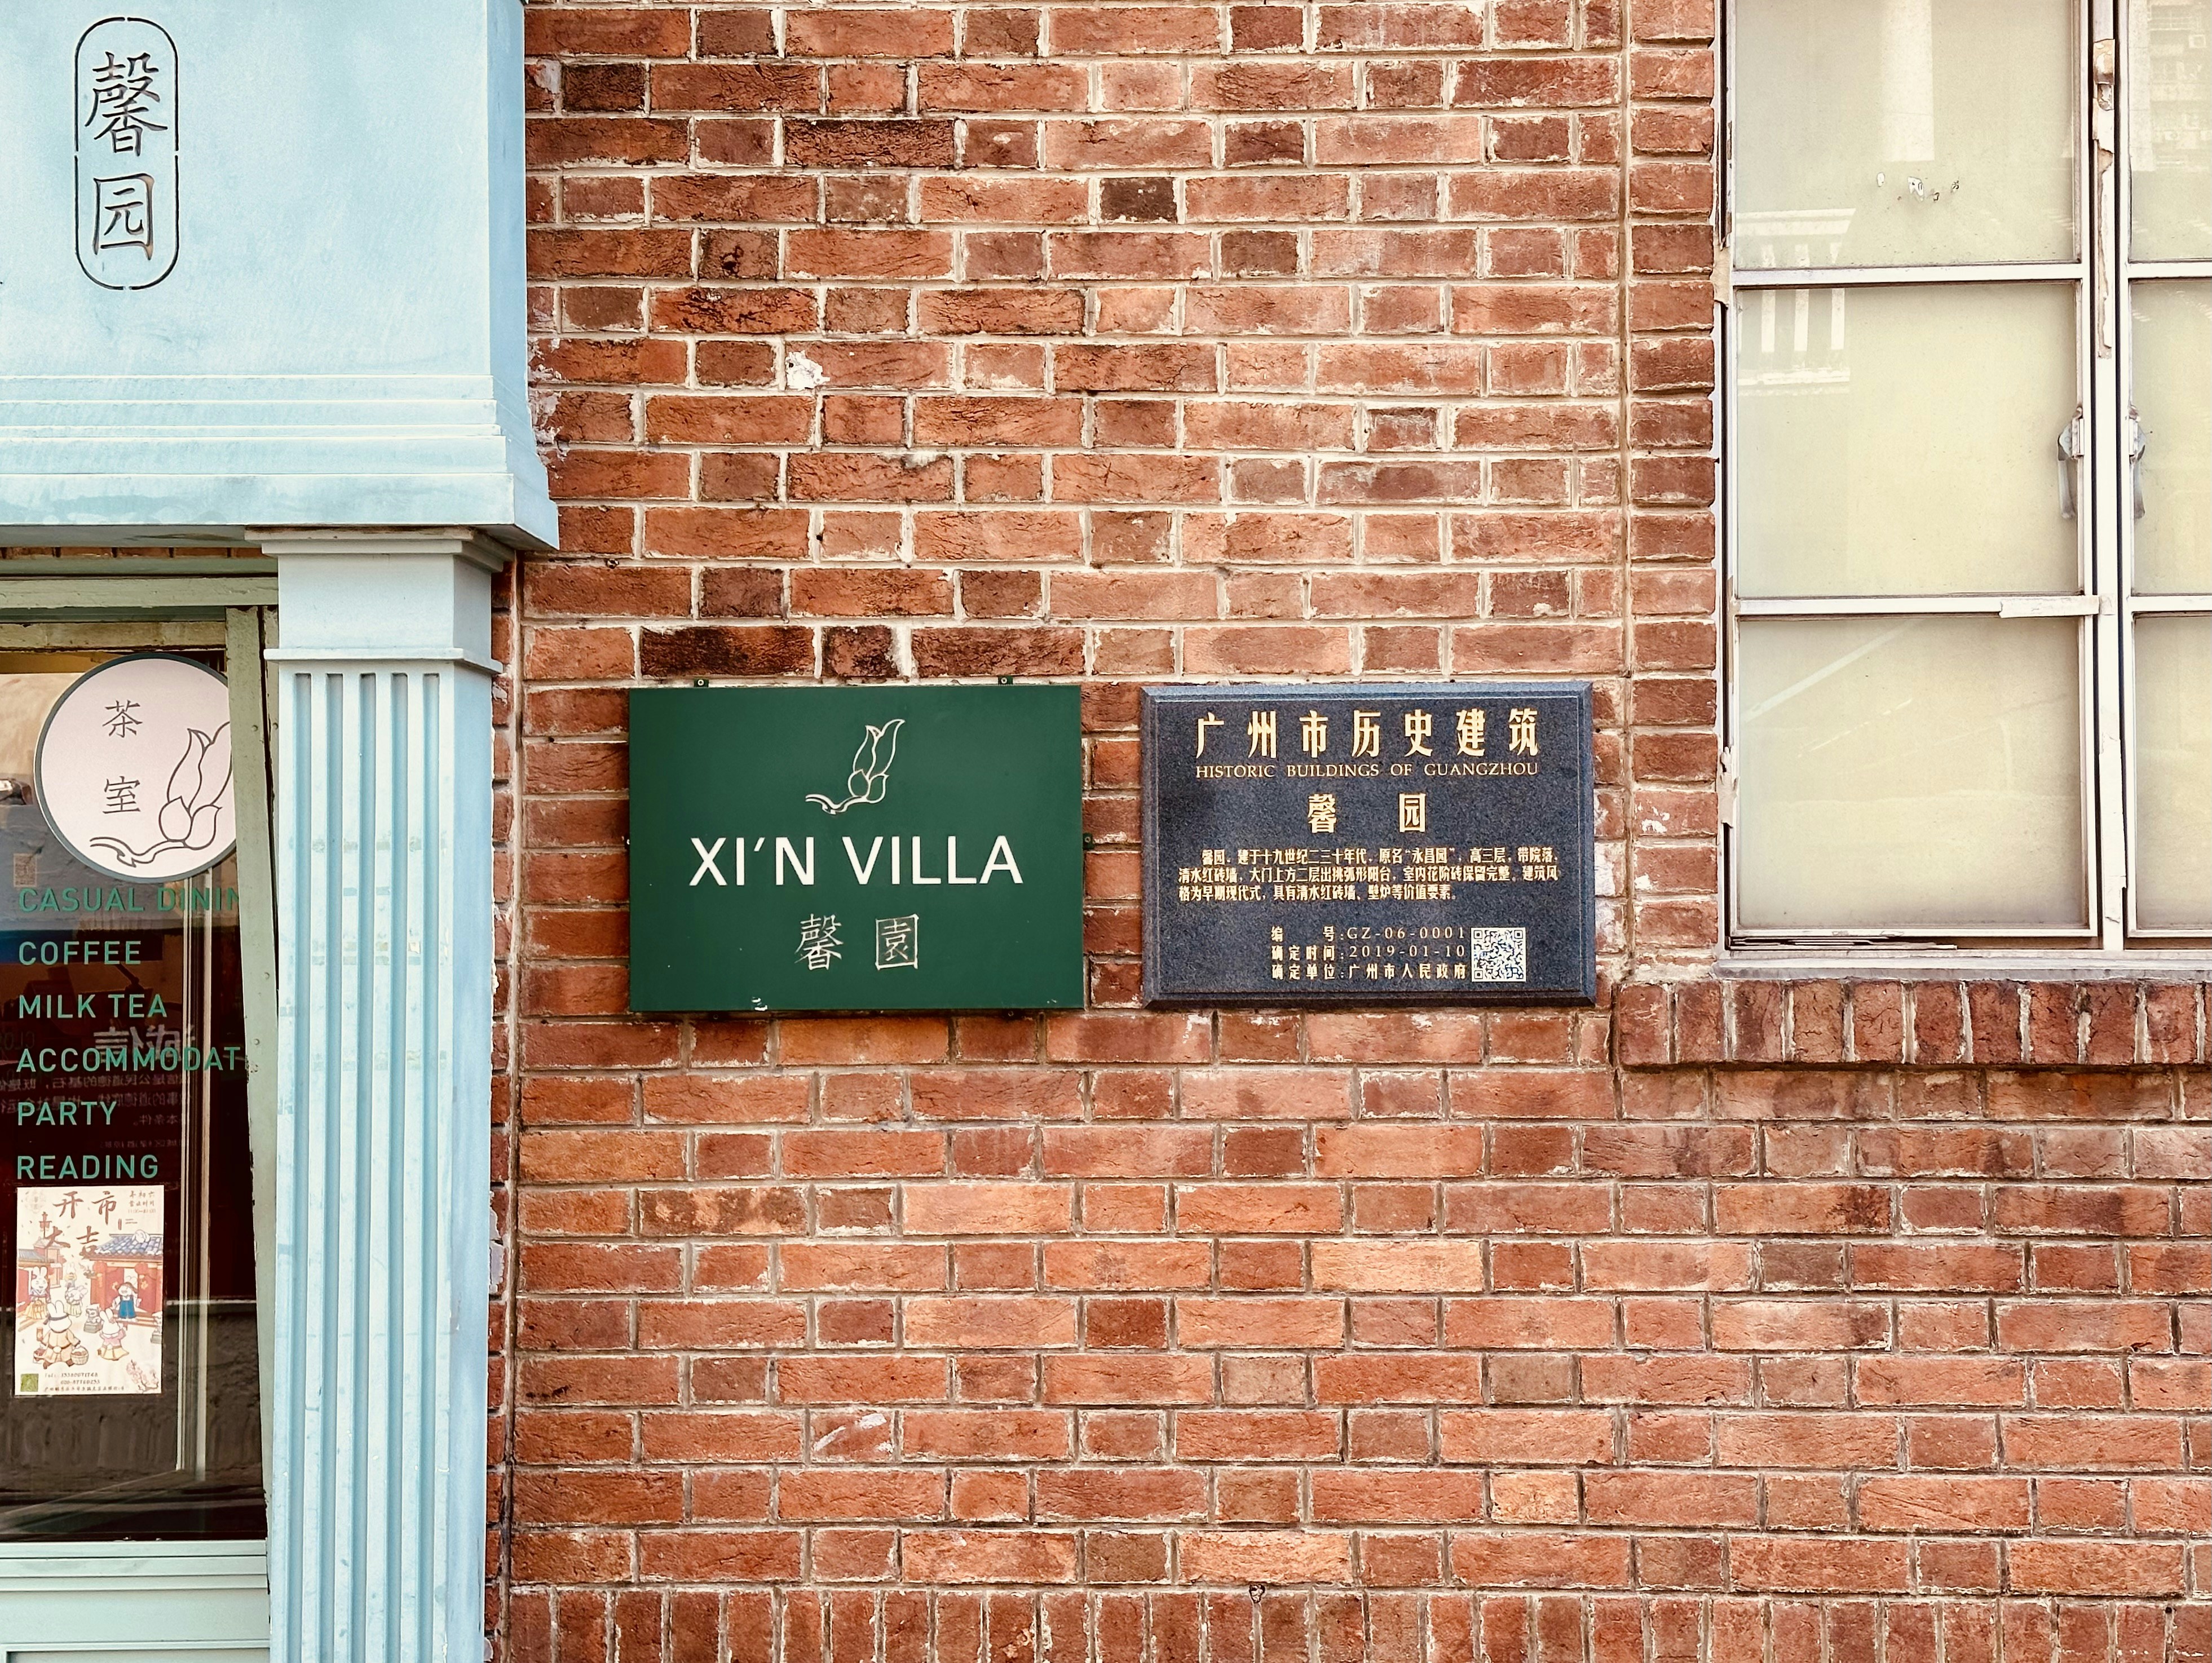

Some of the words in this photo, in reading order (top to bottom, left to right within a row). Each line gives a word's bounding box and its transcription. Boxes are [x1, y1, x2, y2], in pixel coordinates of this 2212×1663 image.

[85, 51, 168, 260] 馨园
[1195, 708, 1539, 759] 广州市历史建筑
[102, 700, 143, 815] 茶室
[1196, 765, 1275, 779] HISTORIC
[1287, 764, 1380, 777] BUILDINGS
[1390, 764, 1412, 777] OF
[1424, 763, 1538, 776] GUANGZHOU
[1308, 792, 1427, 833] 馨园
[689, 837, 815, 886] XI'N
[842, 835, 1023, 886] VILLA
[19, 887, 145, 912] CASUAL
[19, 940, 142, 966] COFFEE
[795, 913, 920, 971] 馨園
[19, 994, 96, 1019] MILK
[108, 994, 167, 1018] TEA
[16, 1046, 241, 1072] ACCOMMODAT
[18, 1101, 117, 1126] PARTY
[17, 1155, 158, 1179] READING
[52, 1191, 117, 1226] 开市
